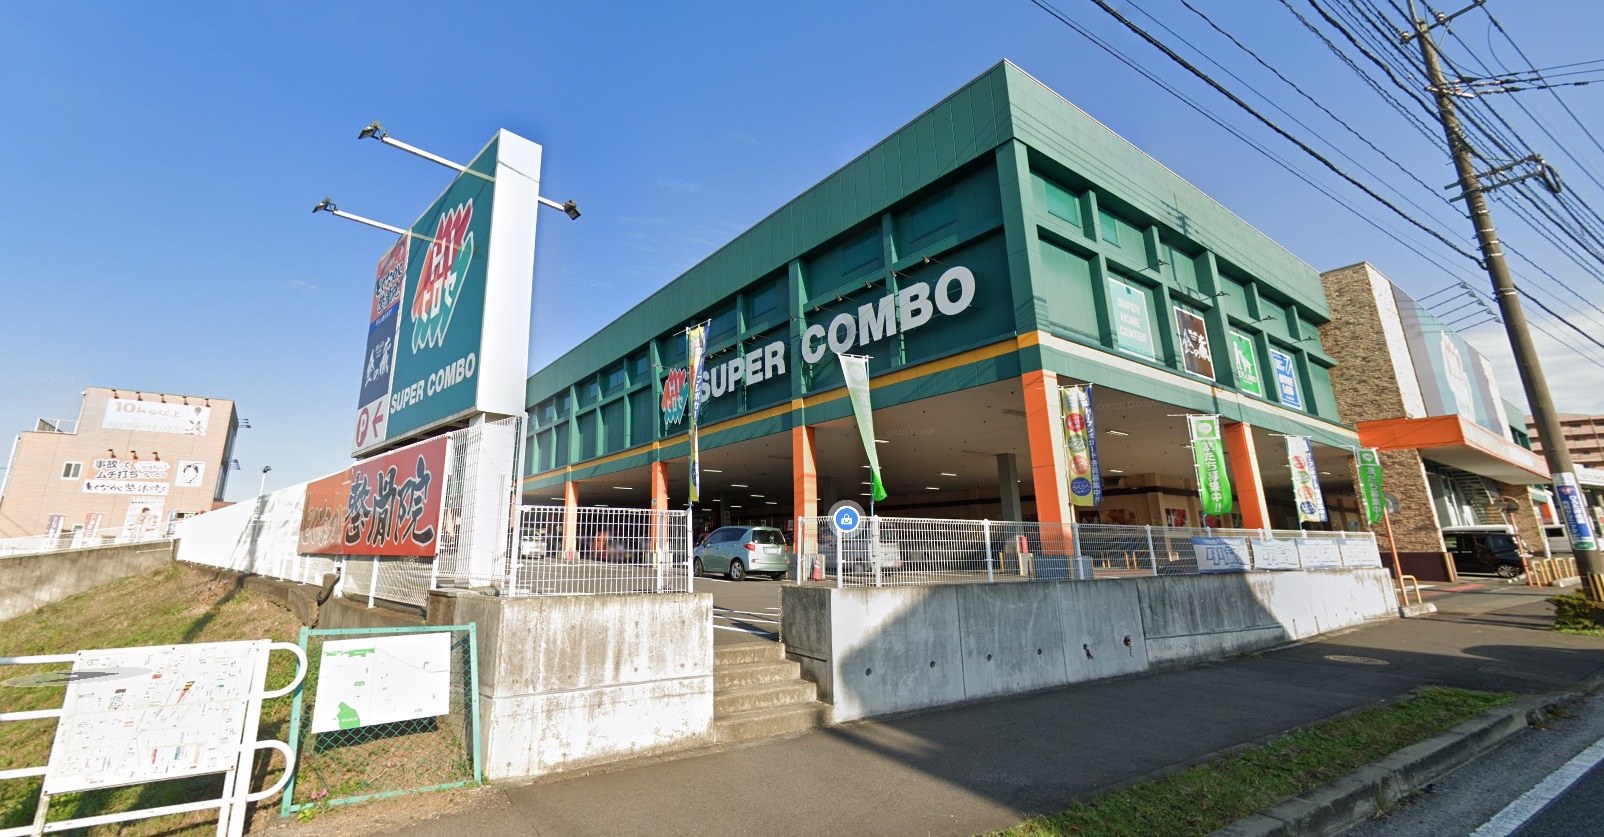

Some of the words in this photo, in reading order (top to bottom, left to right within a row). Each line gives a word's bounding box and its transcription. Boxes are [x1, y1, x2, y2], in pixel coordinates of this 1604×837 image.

[430, 229, 456, 280] HI
[421, 271, 457, 322] ヒロセ
[1117, 297, 1141, 315] SUPER
[1120, 314, 1141, 329] HOME
[700, 340, 786, 403] SUPER
[801, 266, 975, 364] COMBO
[1119, 326, 1147, 344] CENTER
[390, 379, 424, 414] SUPER
[428, 352, 476, 399] COMBO
[669, 379, 681, 398] HI
[667, 396, 687, 414] ヒロセ
